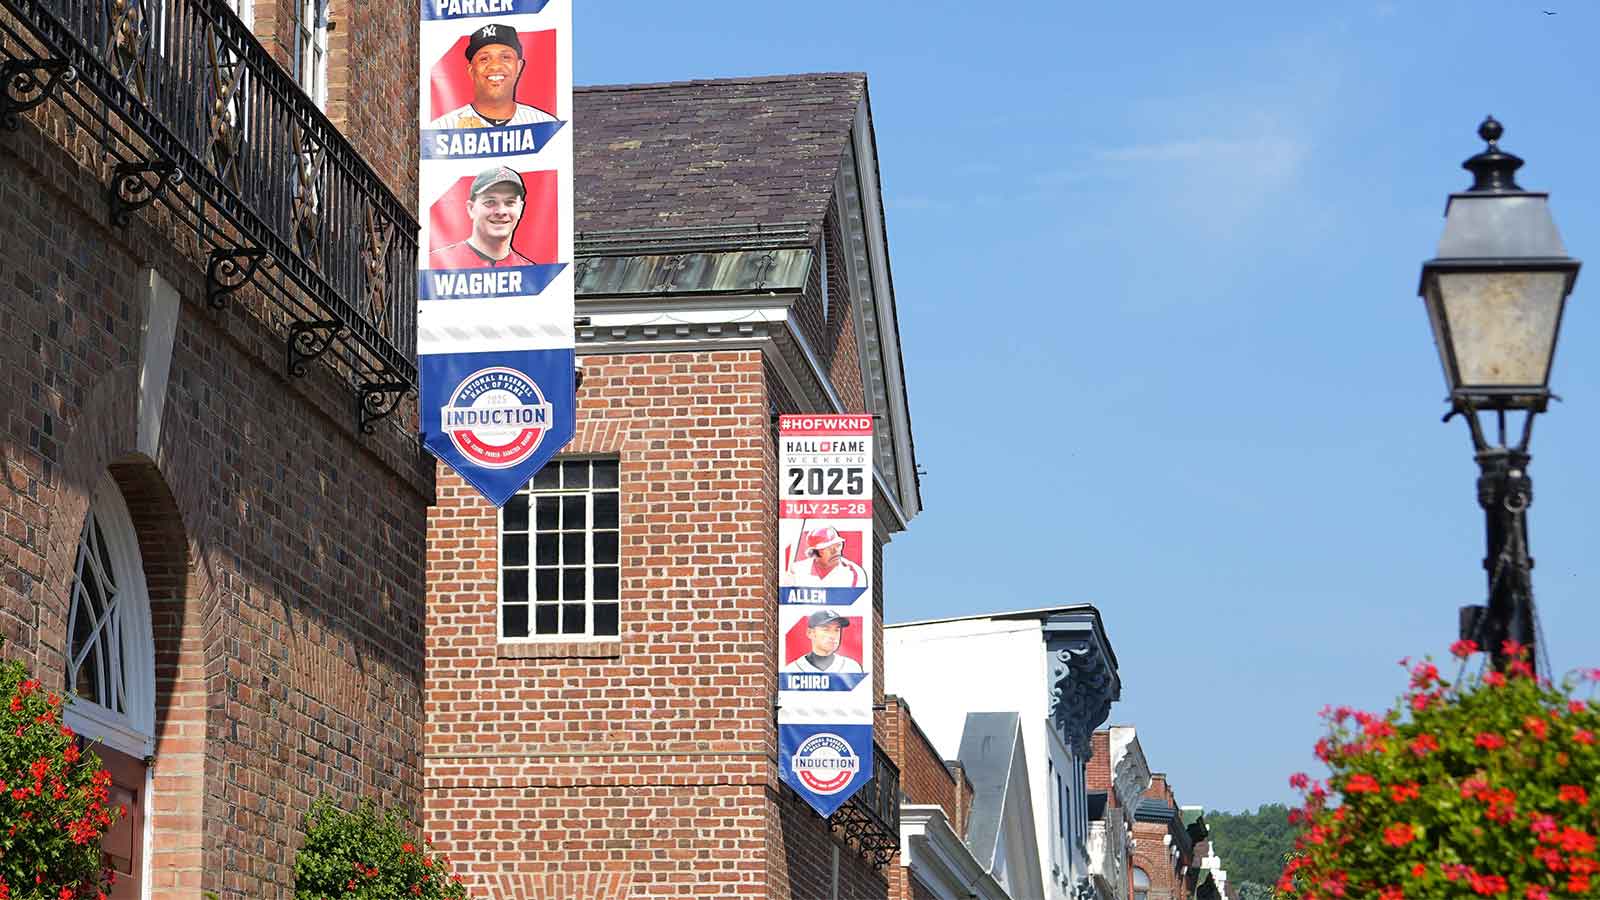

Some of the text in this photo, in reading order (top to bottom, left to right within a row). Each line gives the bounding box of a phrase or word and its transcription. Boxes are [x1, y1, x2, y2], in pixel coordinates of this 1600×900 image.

[436, 129, 535, 156] SABATHIA
[434, 271, 522, 296] WAGNER
[460, 374, 533, 400] NATIONAL BASEBALL
[470, 383, 490, 399] HALL
[504, 382, 524, 397] FAME
[447, 408, 545, 425] INDUCTION
[782, 419, 870, 429] #HOFWKND
[787, 441, 817, 452] HALL
[833, 441, 865, 452] FAME
[788, 467, 863, 495] 2025
[786, 503, 819, 514] JULY
[788, 589, 826, 603] ALLEN
[788, 674, 829, 689] ICHIRO
[795, 759, 855, 768] INDUCTION
